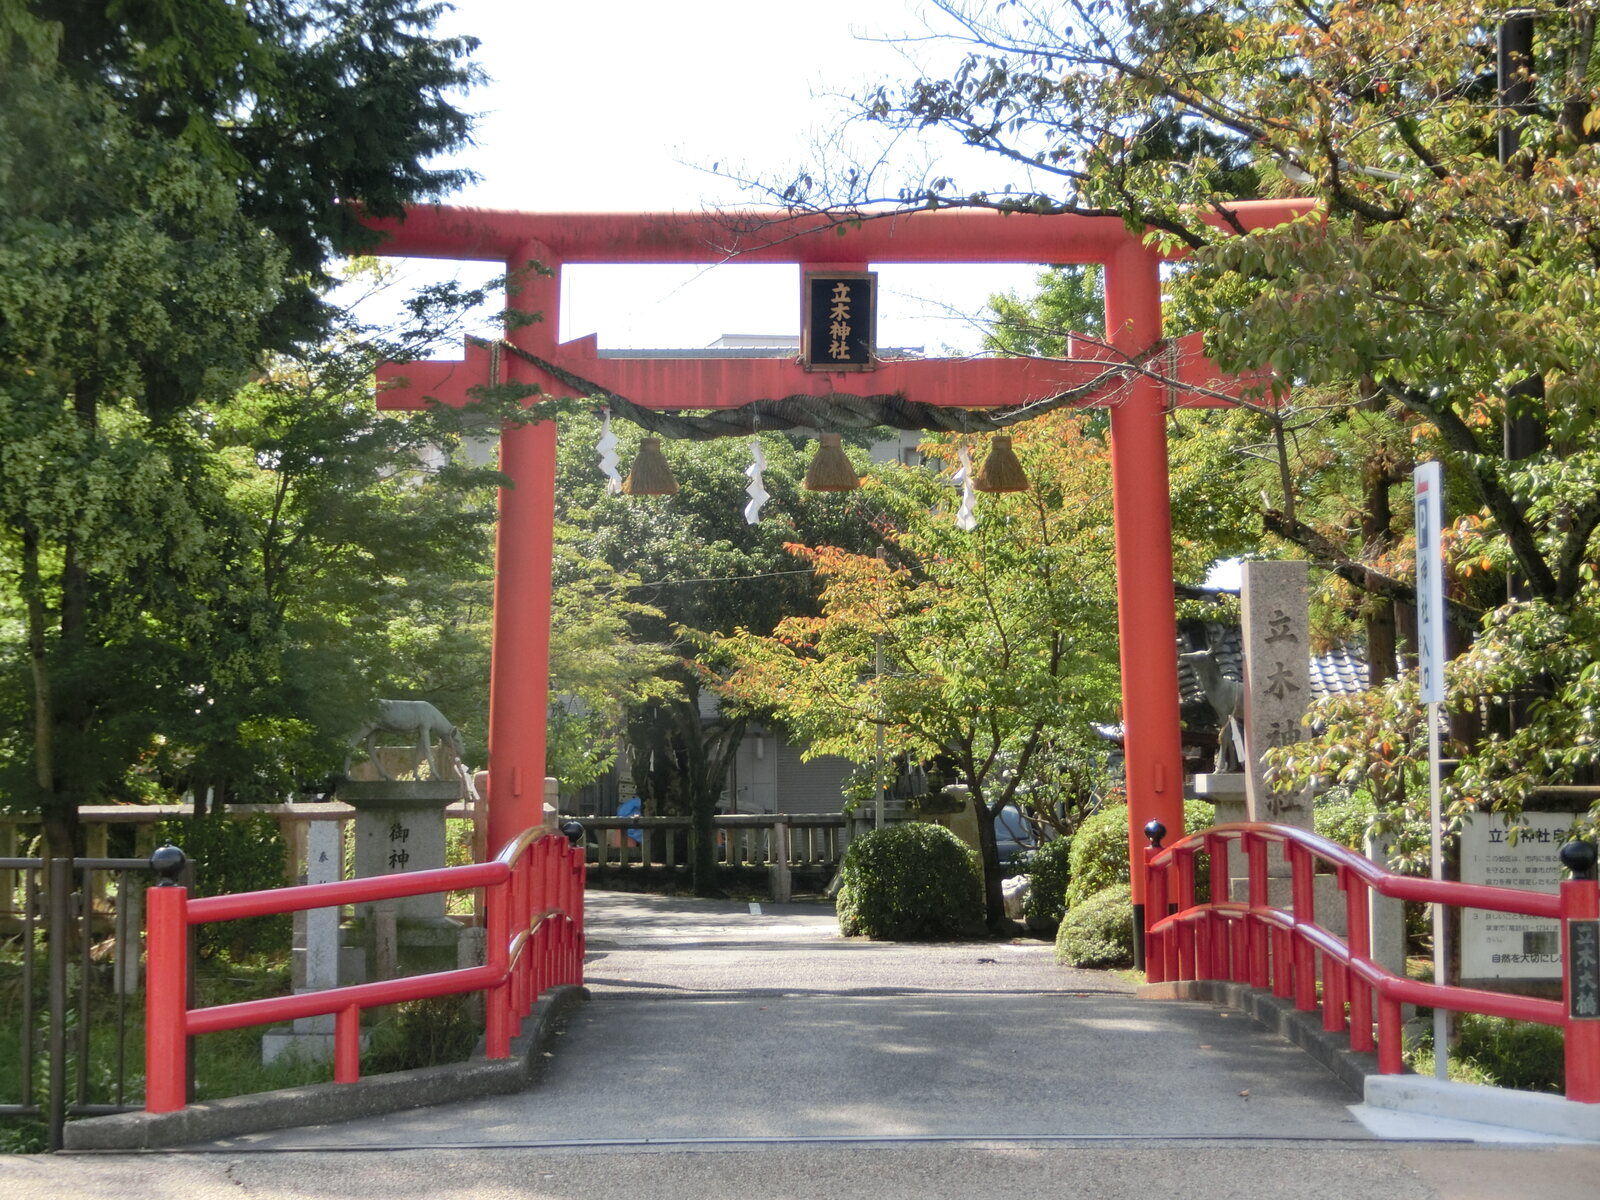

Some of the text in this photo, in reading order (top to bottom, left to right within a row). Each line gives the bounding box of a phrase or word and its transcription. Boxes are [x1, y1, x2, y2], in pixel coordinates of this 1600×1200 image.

[828, 282, 851, 360] 立木神社
[1419, 505, 1426, 545] P
[1421, 556, 1430, 690] 神社入口
[1264, 609, 1302, 816] 立木神社
[318, 851, 329, 884] 奉
[388, 823, 410, 869] 御神
